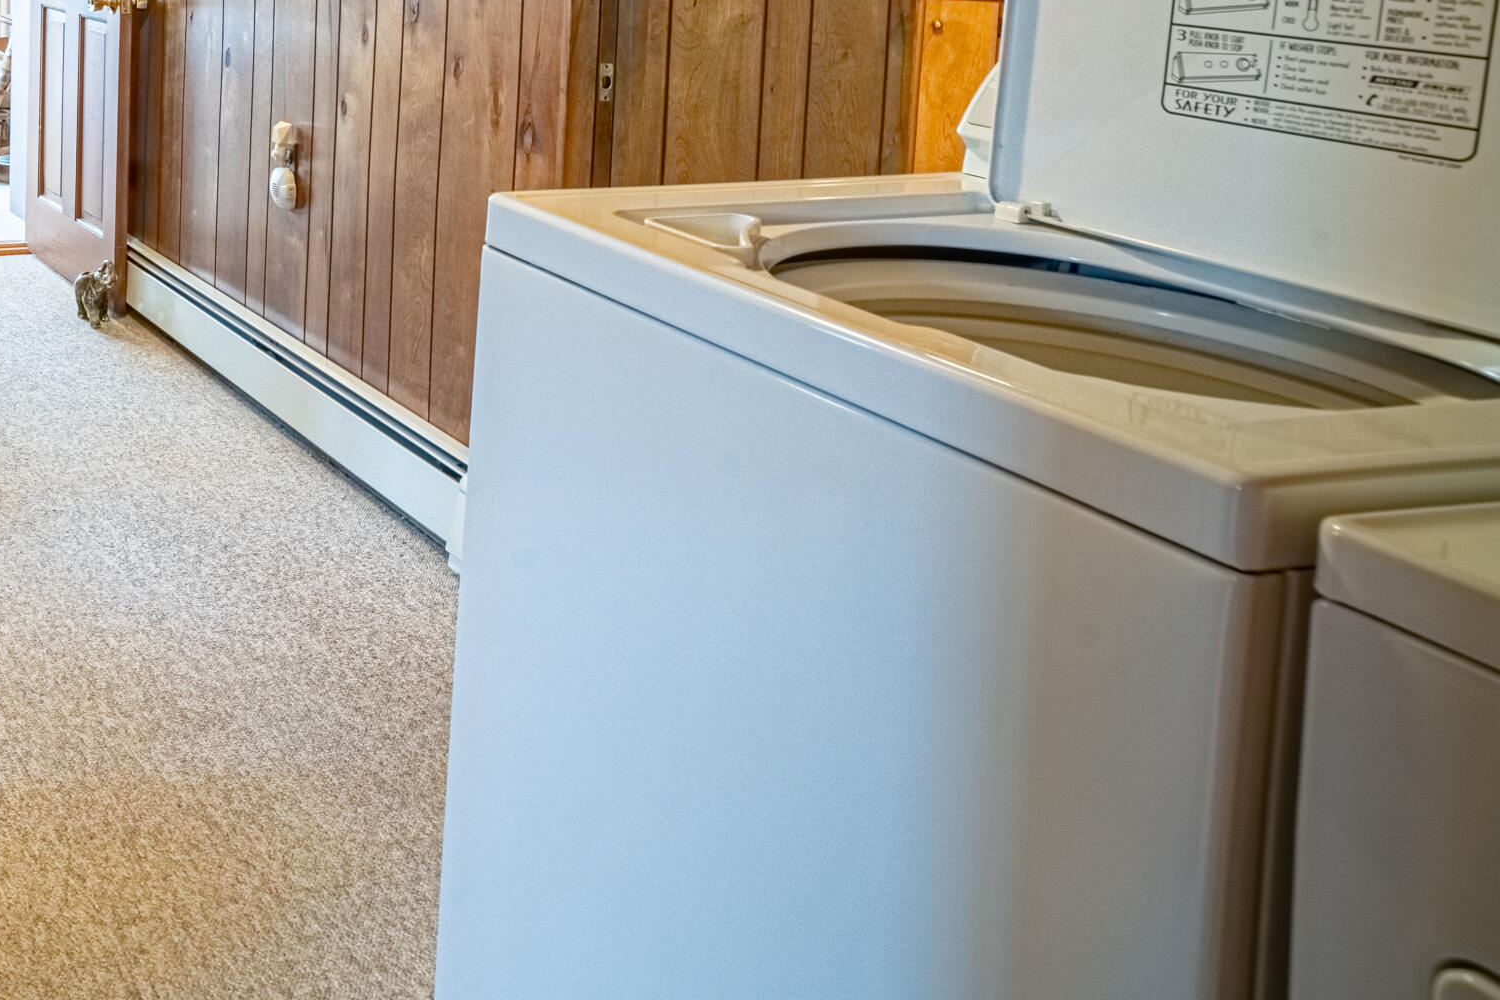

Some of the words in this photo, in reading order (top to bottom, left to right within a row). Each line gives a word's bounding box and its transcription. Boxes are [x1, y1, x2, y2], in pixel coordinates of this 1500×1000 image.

[1176, 29, 1187, 41] 3
[1365, 50, 1380, 60] FOR
[1382, 52, 1402, 63] MORE
[1175, 89, 1198, 100] FOR
[1203, 92, 1237, 105] YOUR
[1174, 99, 1236, 117] SAFETY
